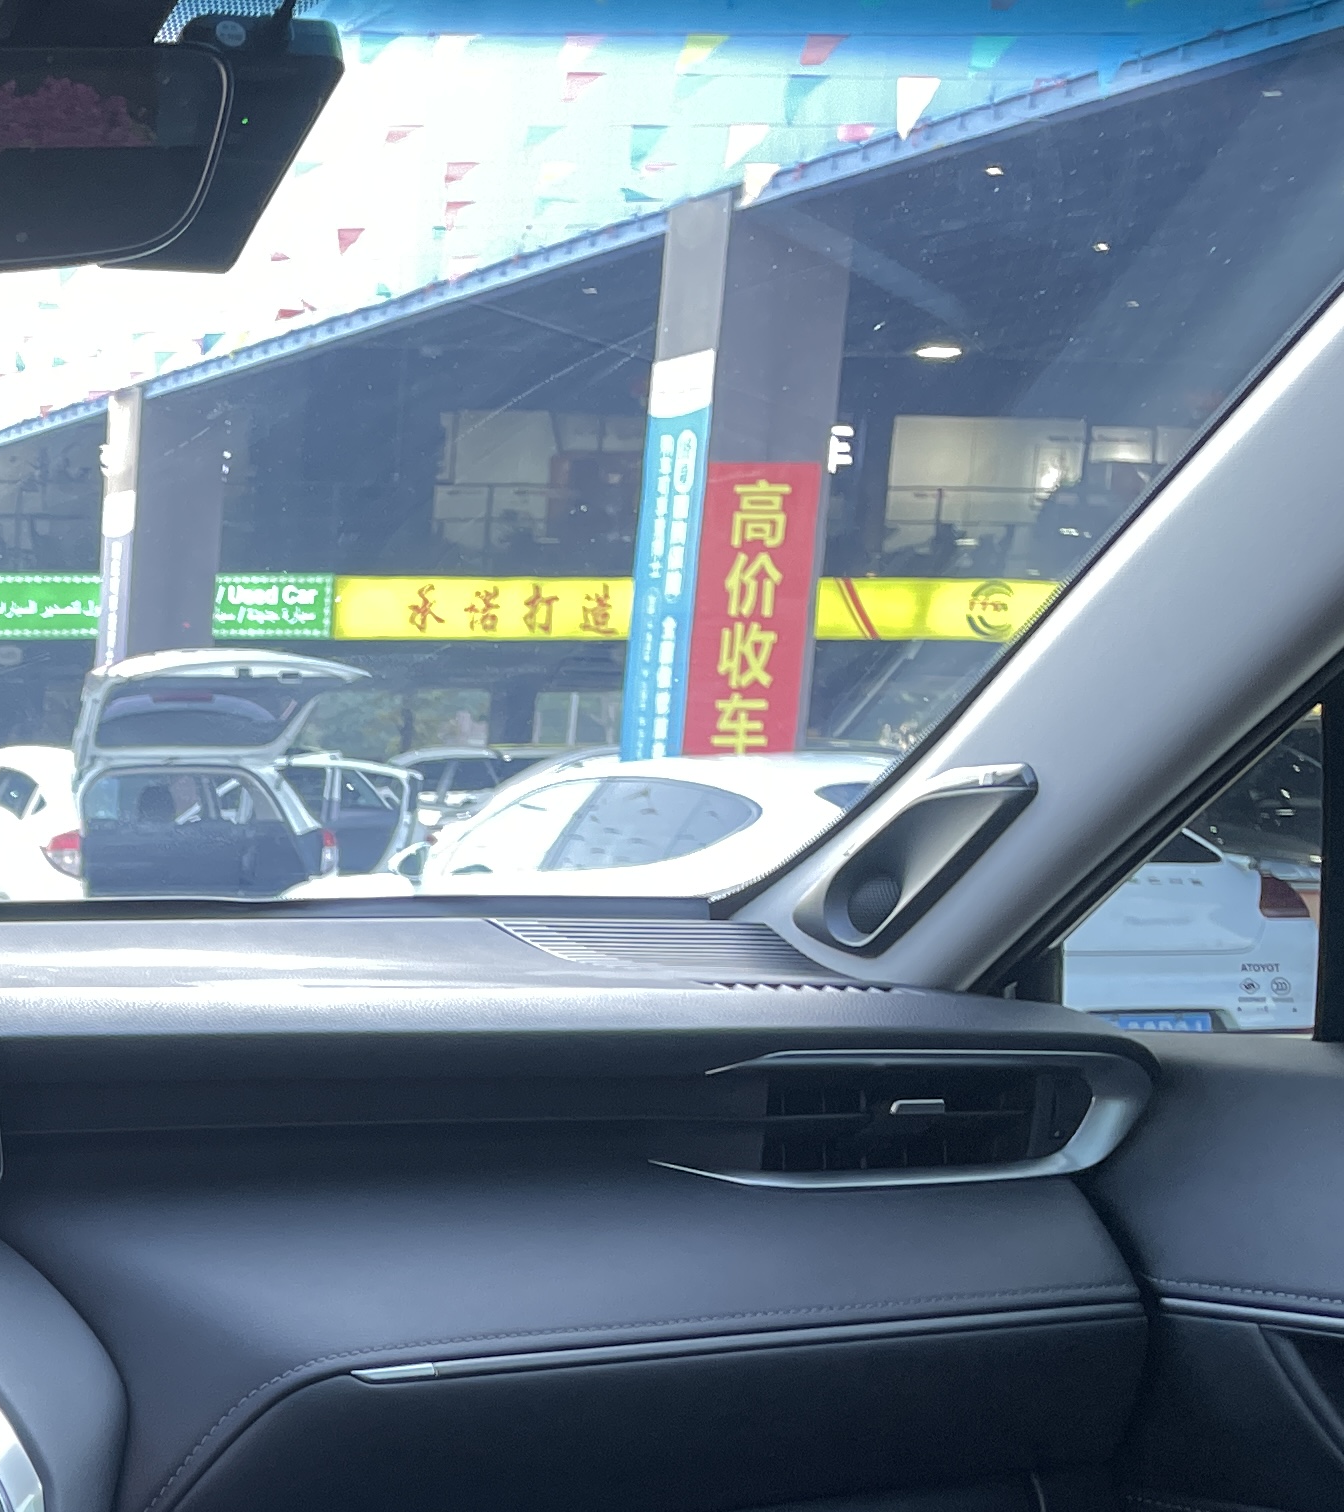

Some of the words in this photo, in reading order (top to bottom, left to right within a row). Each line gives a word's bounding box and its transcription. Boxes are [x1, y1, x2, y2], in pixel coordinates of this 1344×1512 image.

[227, 585, 279, 606] Used
[281, 585, 319, 605] Car
[711, 479, 793, 755] 高价收车
